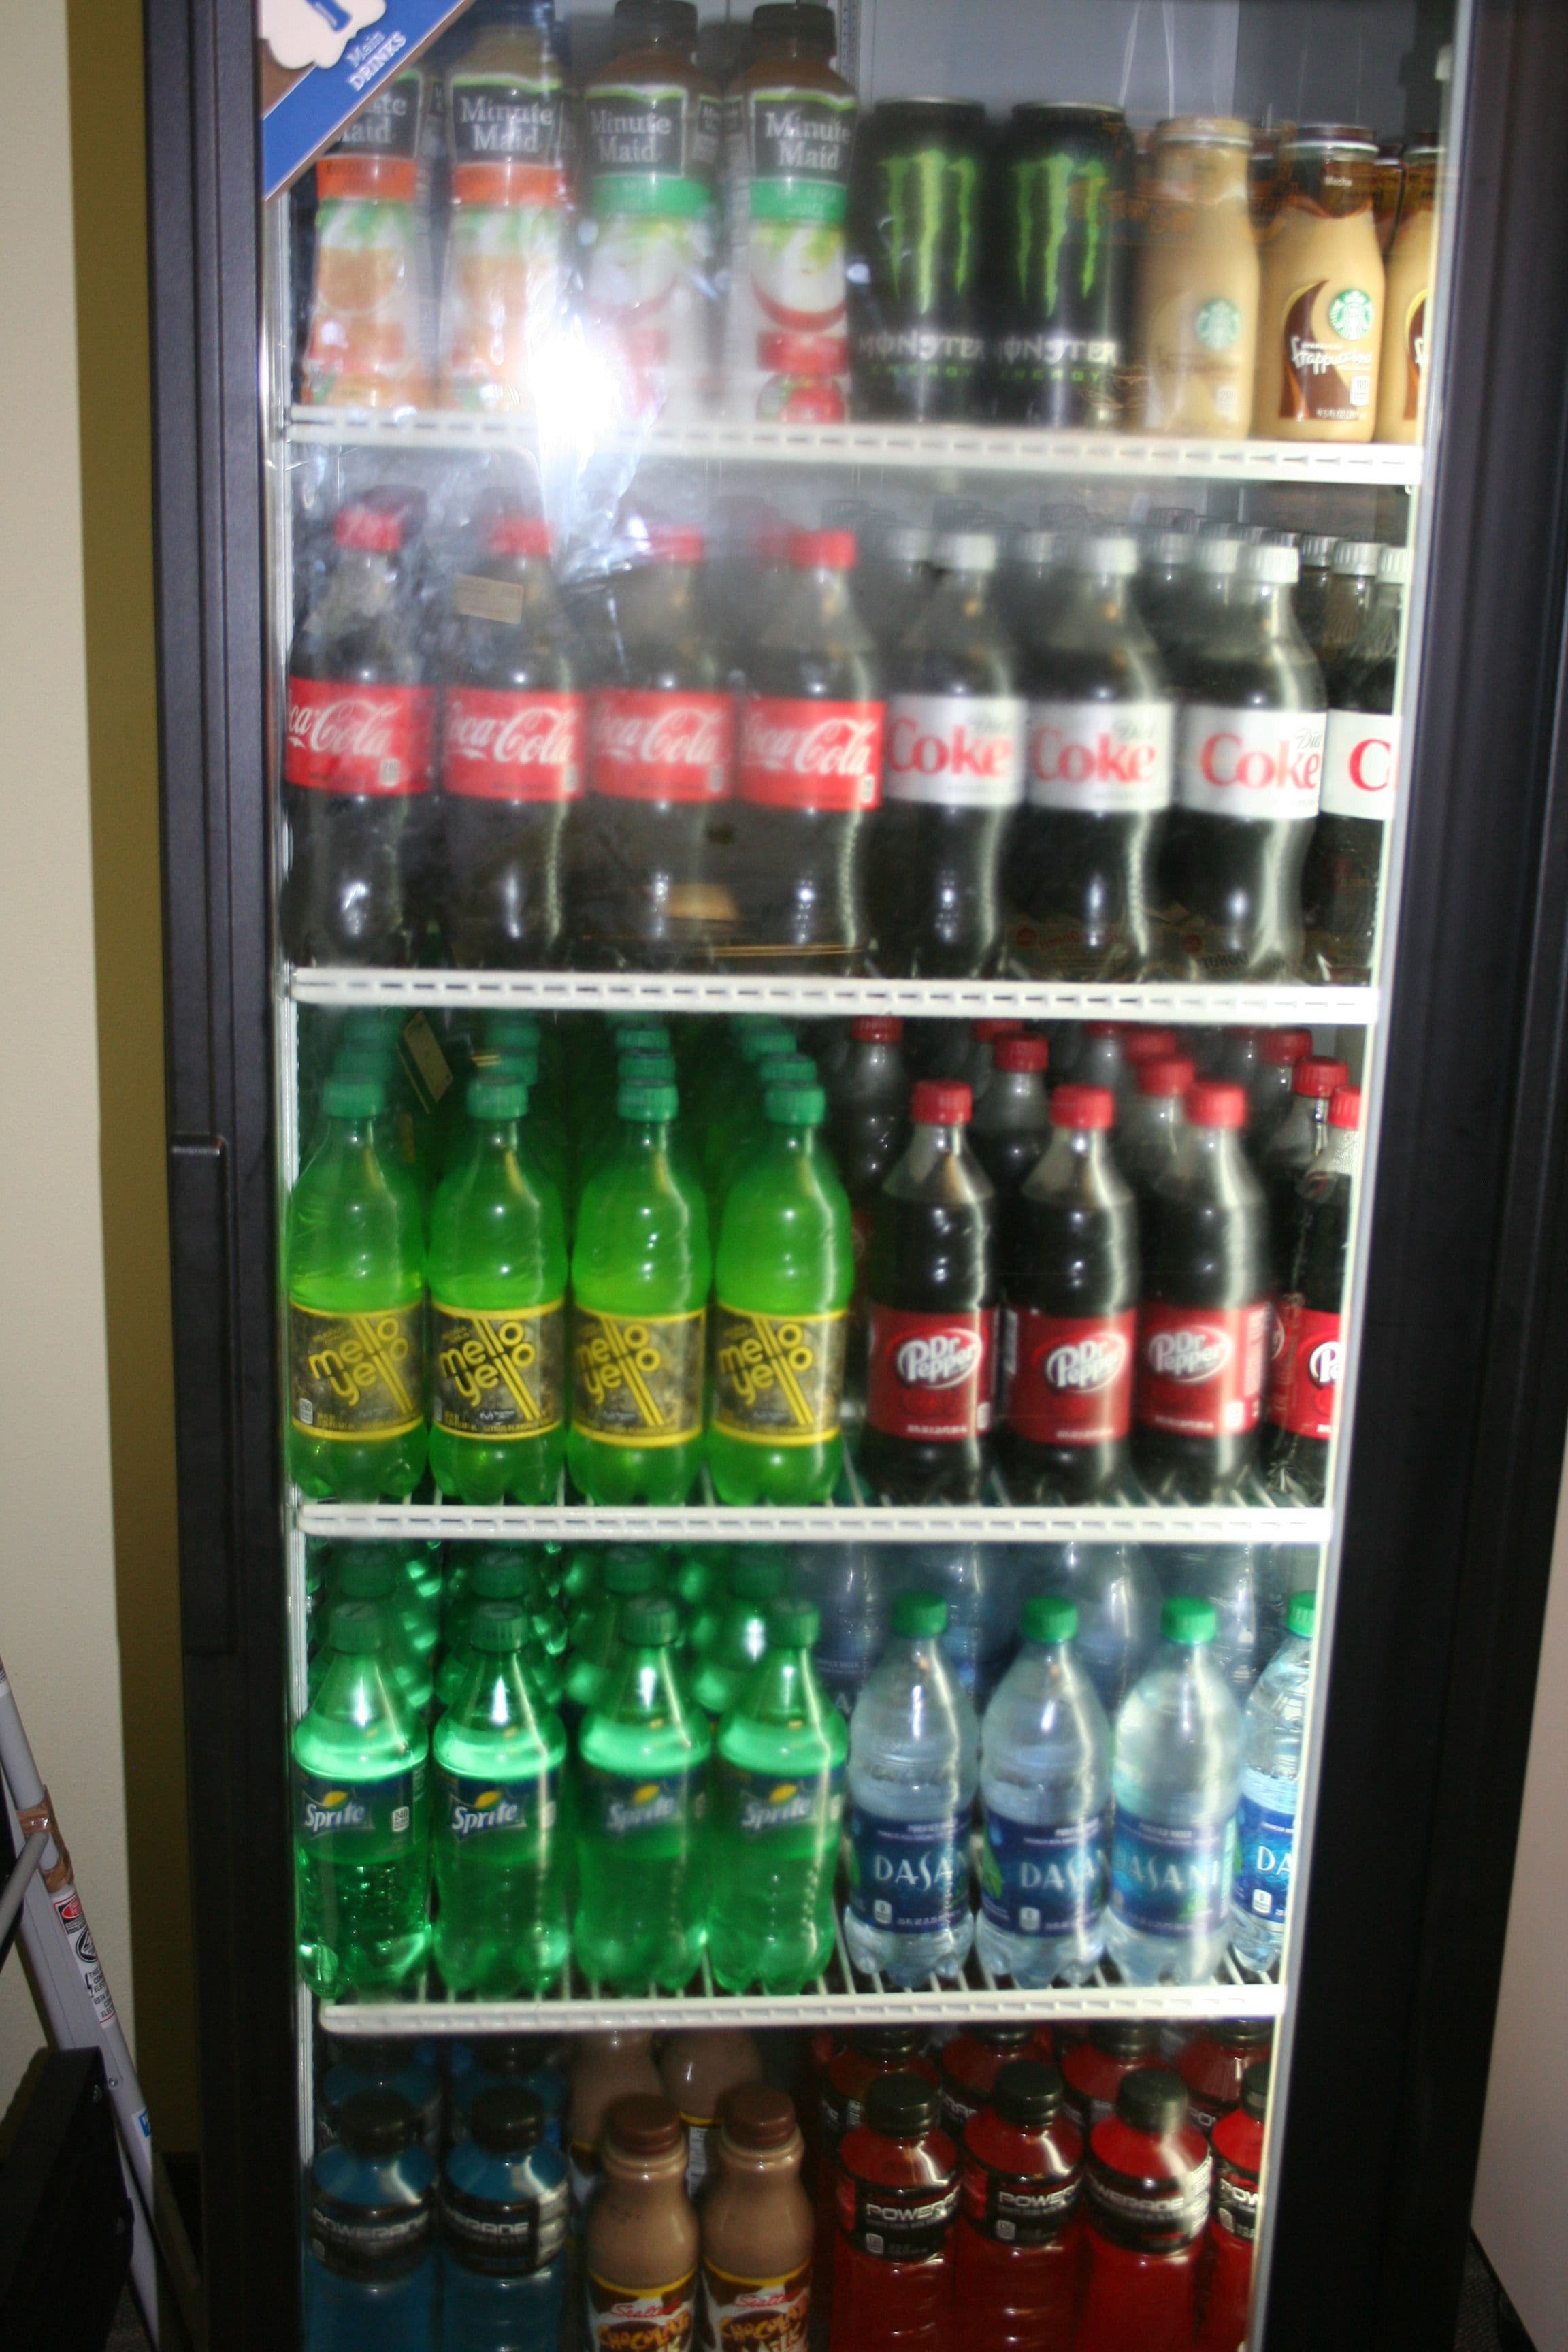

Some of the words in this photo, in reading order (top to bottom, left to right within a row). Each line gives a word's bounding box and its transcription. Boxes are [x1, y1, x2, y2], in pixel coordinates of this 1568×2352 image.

[348, 31, 406, 91] DRINKS
[461, 97, 554, 125] Minute
[590, 108, 672, 135] Minute
[766, 109, 850, 144] Minute
[474, 124, 540, 152] Maid
[599, 136, 658, 163] Maid
[779, 142, 840, 171] Maid
[289, 699, 403, 757] ca-Cola
[887, 716, 1013, 777] Coke
[1031, 725, 1156, 783] Coke
[1200, 732, 1321, 789] Coke
[930, 1335, 961, 1357] Dr
[1079, 1340, 1109, 1361] Dr
[1156, 1334, 1220, 1375] Pepper
[1175, 1330, 1206, 1354] Dr
[907, 1341, 977, 1383] Pepper
[1057, 1348, 1120, 1388] Pepper
[305, 1800, 365, 1833] Sprite
[452, 1801, 518, 1834] Sprite
[607, 1797, 674, 1832] Sprite
[742, 1796, 811, 1829] Sprite
